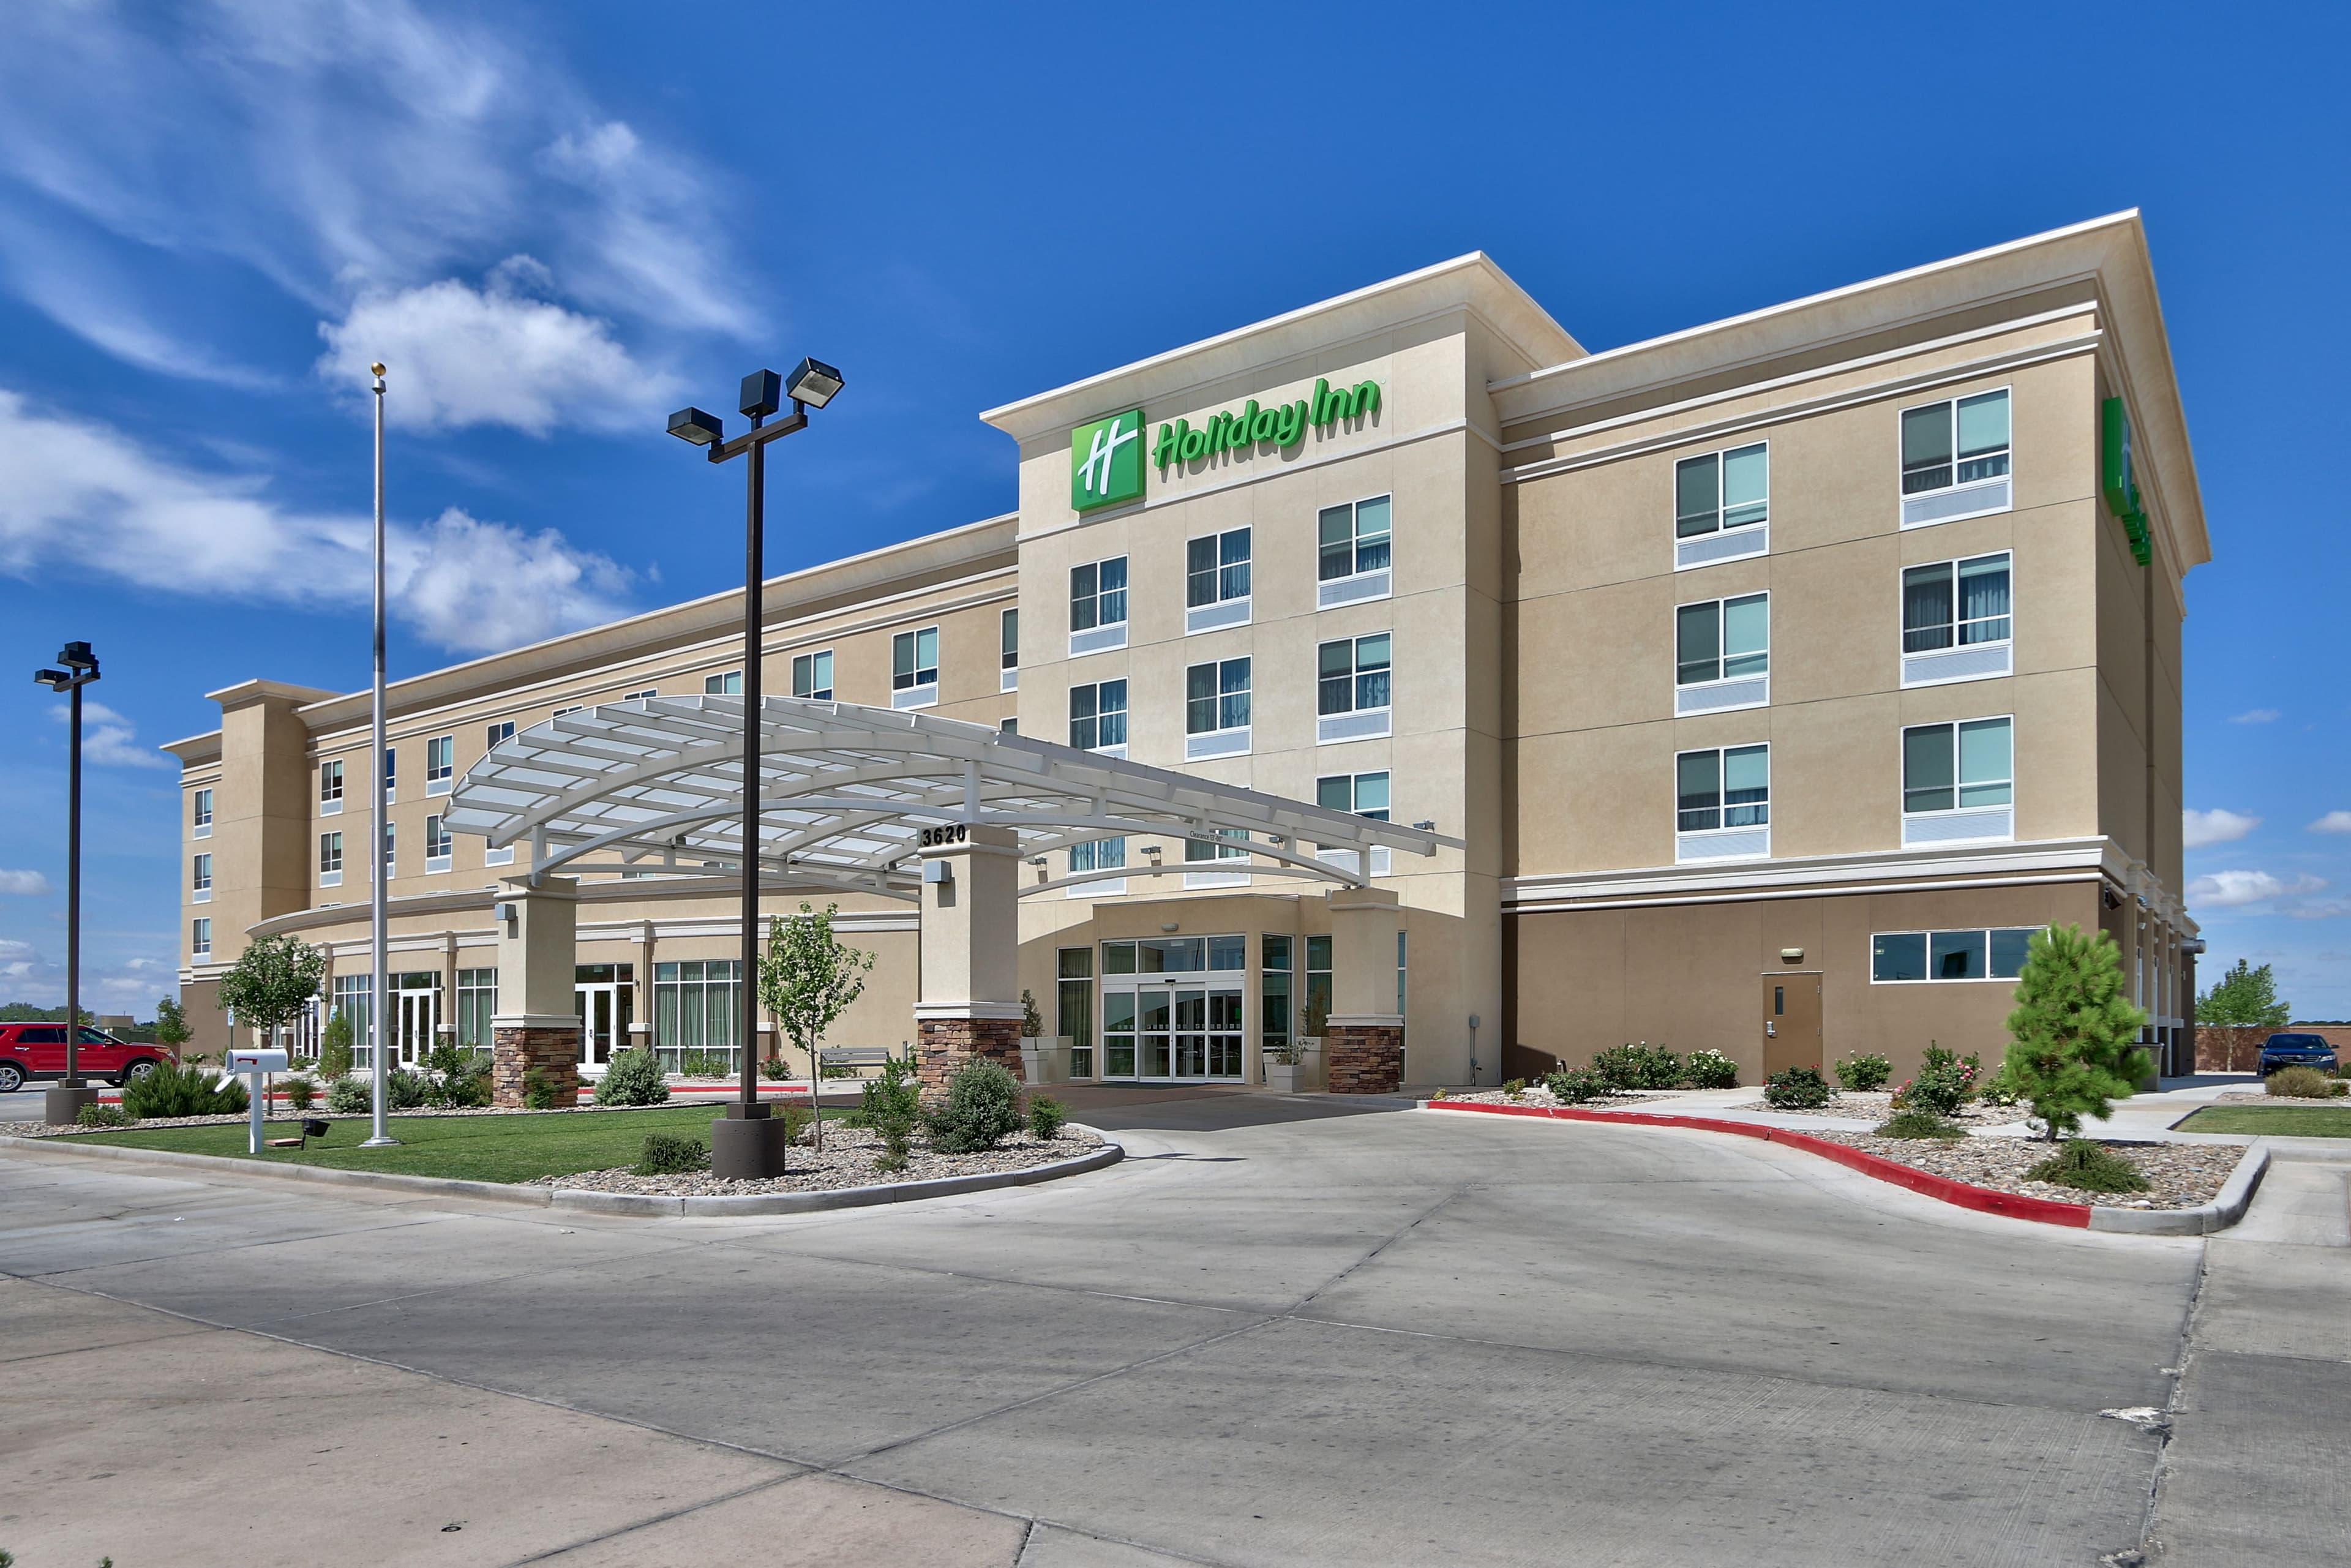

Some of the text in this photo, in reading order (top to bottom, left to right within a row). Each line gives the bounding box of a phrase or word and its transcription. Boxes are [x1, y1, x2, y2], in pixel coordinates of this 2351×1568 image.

[1152, 378, 1380, 468] Holiday Inn
[923, 824, 966, 846] 3620
[1190, 830, 1209, 840] Clearance
